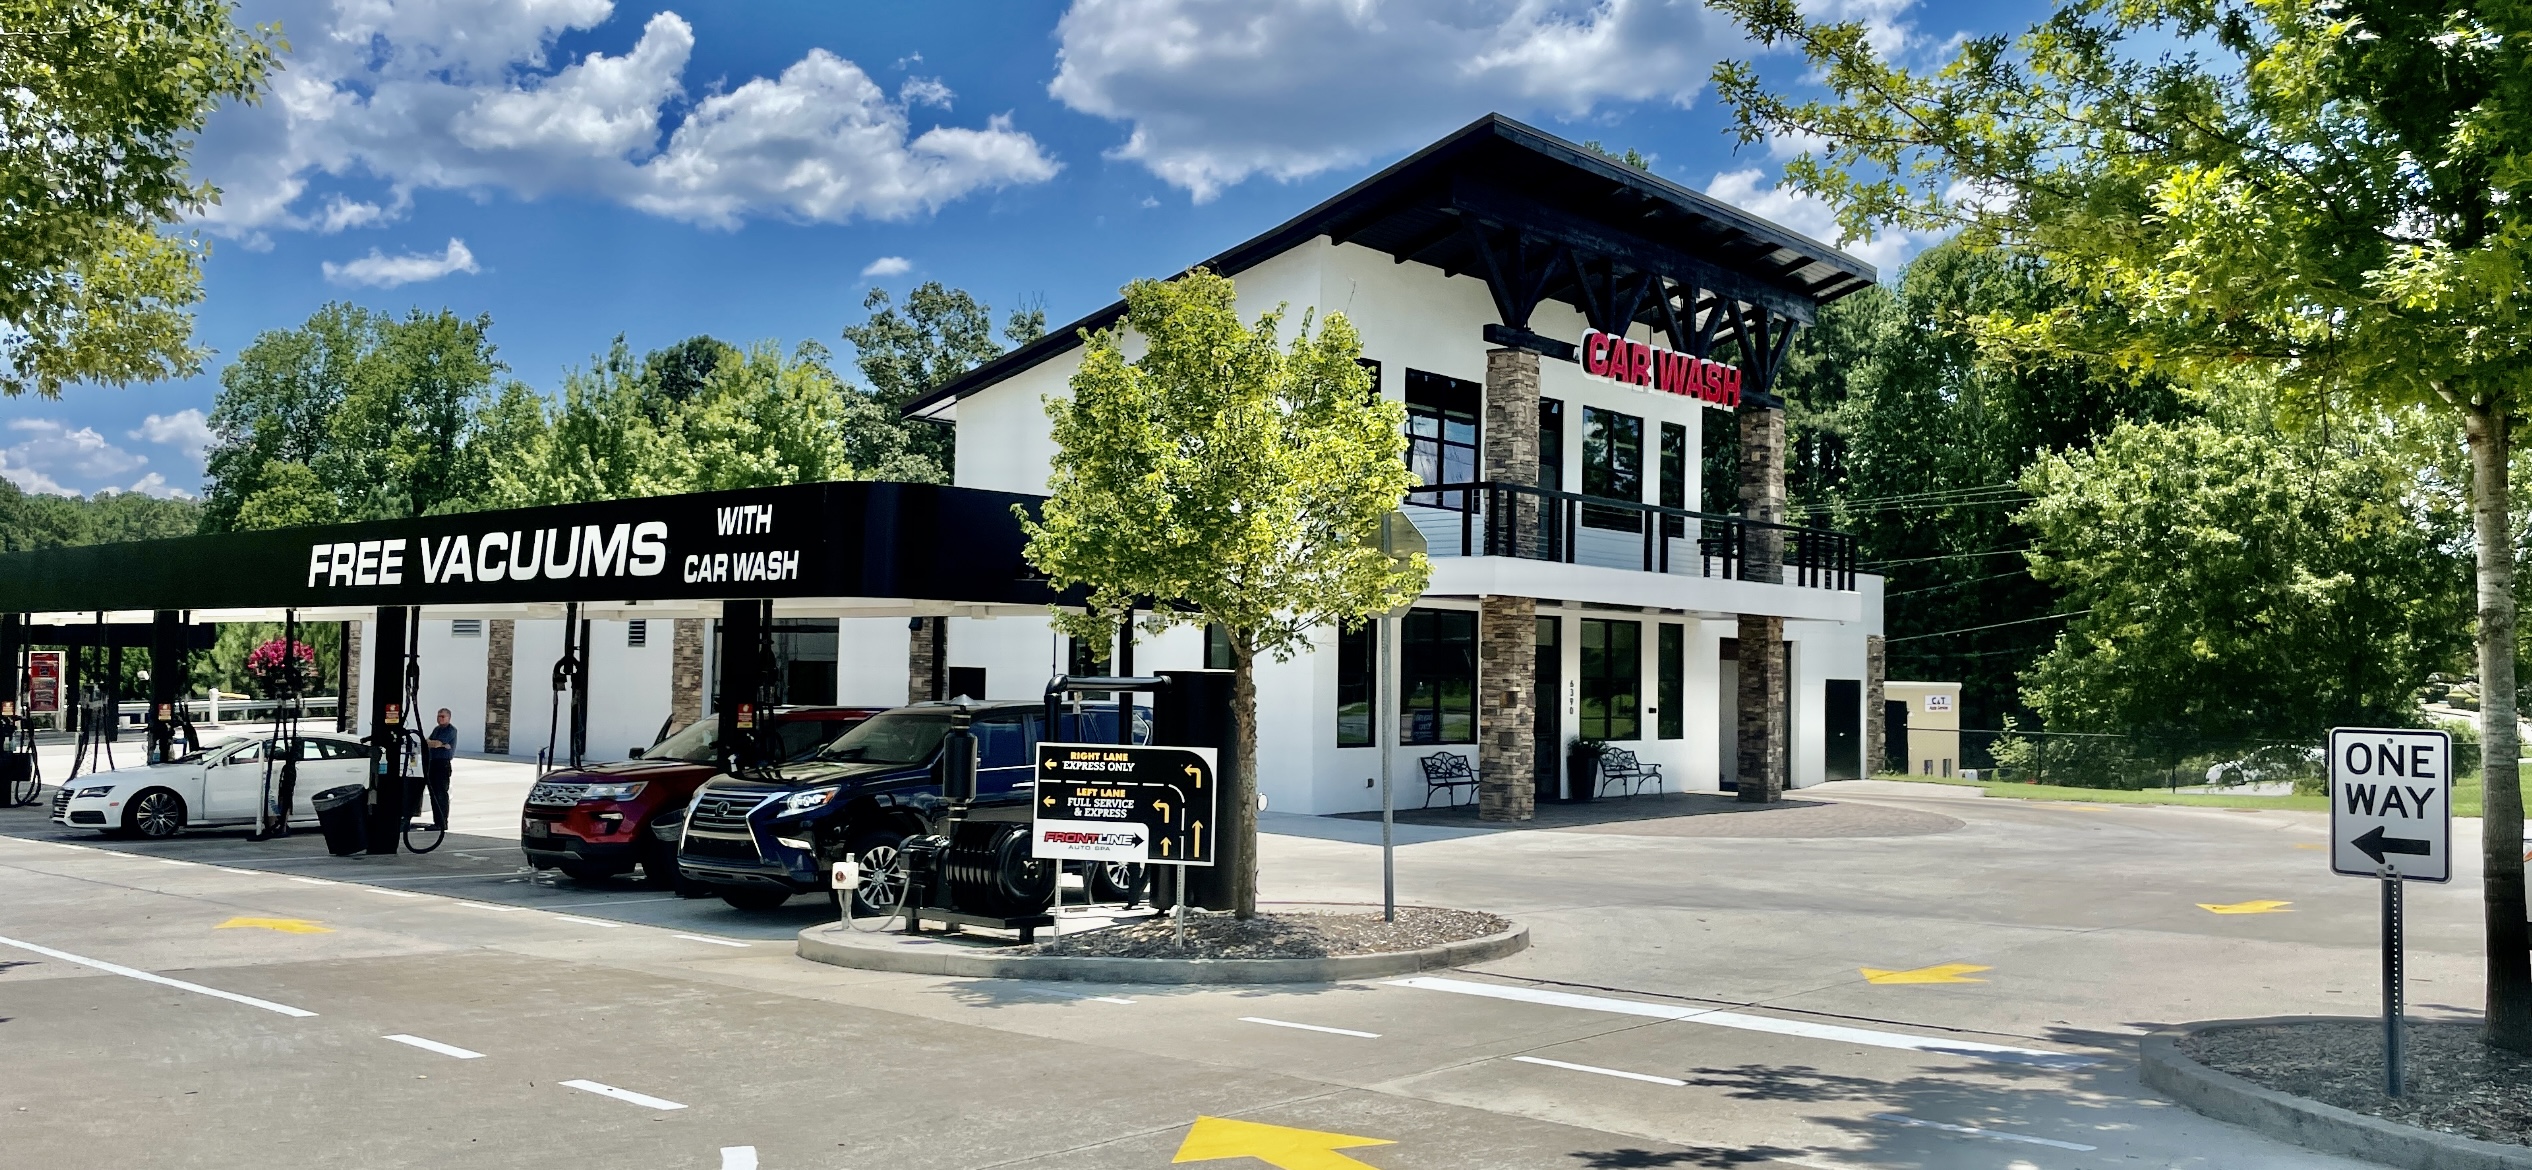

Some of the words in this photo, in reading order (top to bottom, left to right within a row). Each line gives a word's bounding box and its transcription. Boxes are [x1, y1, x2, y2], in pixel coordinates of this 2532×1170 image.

[1588, 332, 1651, 387] CAR
[1659, 350, 1742, 409] WASH
[717, 503, 773, 536] WITH
[307, 538, 407, 588] FREE
[420, 521, 668, 584] VACUUMS
[683, 553, 729, 584] CAR
[732, 549, 800, 582] WASH
[1062, 760, 1106, 771] EXPRESS
[1107, 762, 1135, 772] ONLY
[1070, 751, 1101, 761] RIGHT
[1103, 752, 1129, 762] LANE
[2345, 742, 2436, 779] ONE
[1067, 797, 1092, 808] FULL
[1093, 798, 1135, 809] SERVICE
[1076, 787, 1099, 797] LEFT
[1100, 788, 1126, 798] LANE
[2345, 783, 2436, 820] WAY
[1073, 808, 1083, 817] &
[1084, 808, 1128, 819] EXPRESS
[1043, 831, 1134, 846] FRONTLINE
